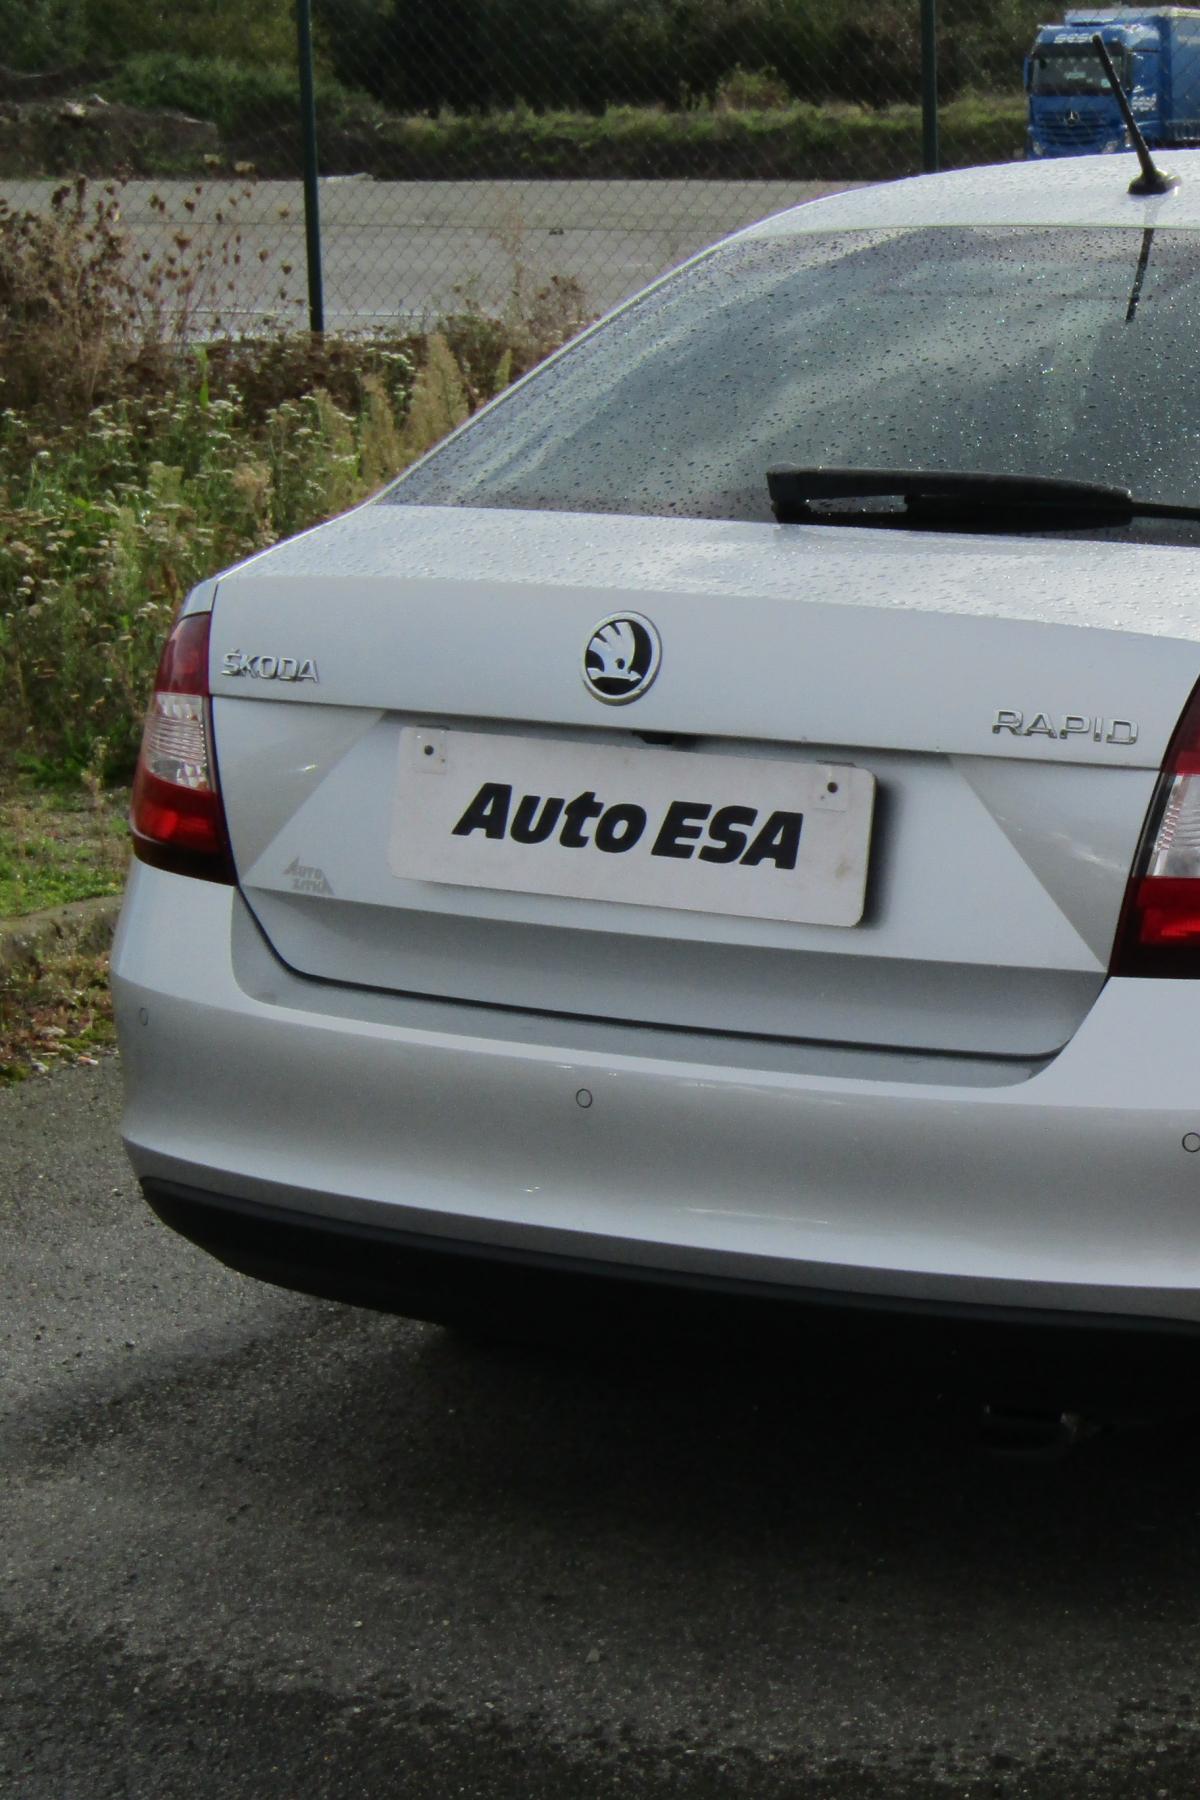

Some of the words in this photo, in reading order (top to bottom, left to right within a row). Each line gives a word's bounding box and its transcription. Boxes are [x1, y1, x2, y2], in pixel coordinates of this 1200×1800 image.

[221, 649, 319, 683] ŠKODA
[992, 709, 1139, 745] RAPID
[451, 782, 647, 853] Auto
[650, 800, 804, 870] ESA
